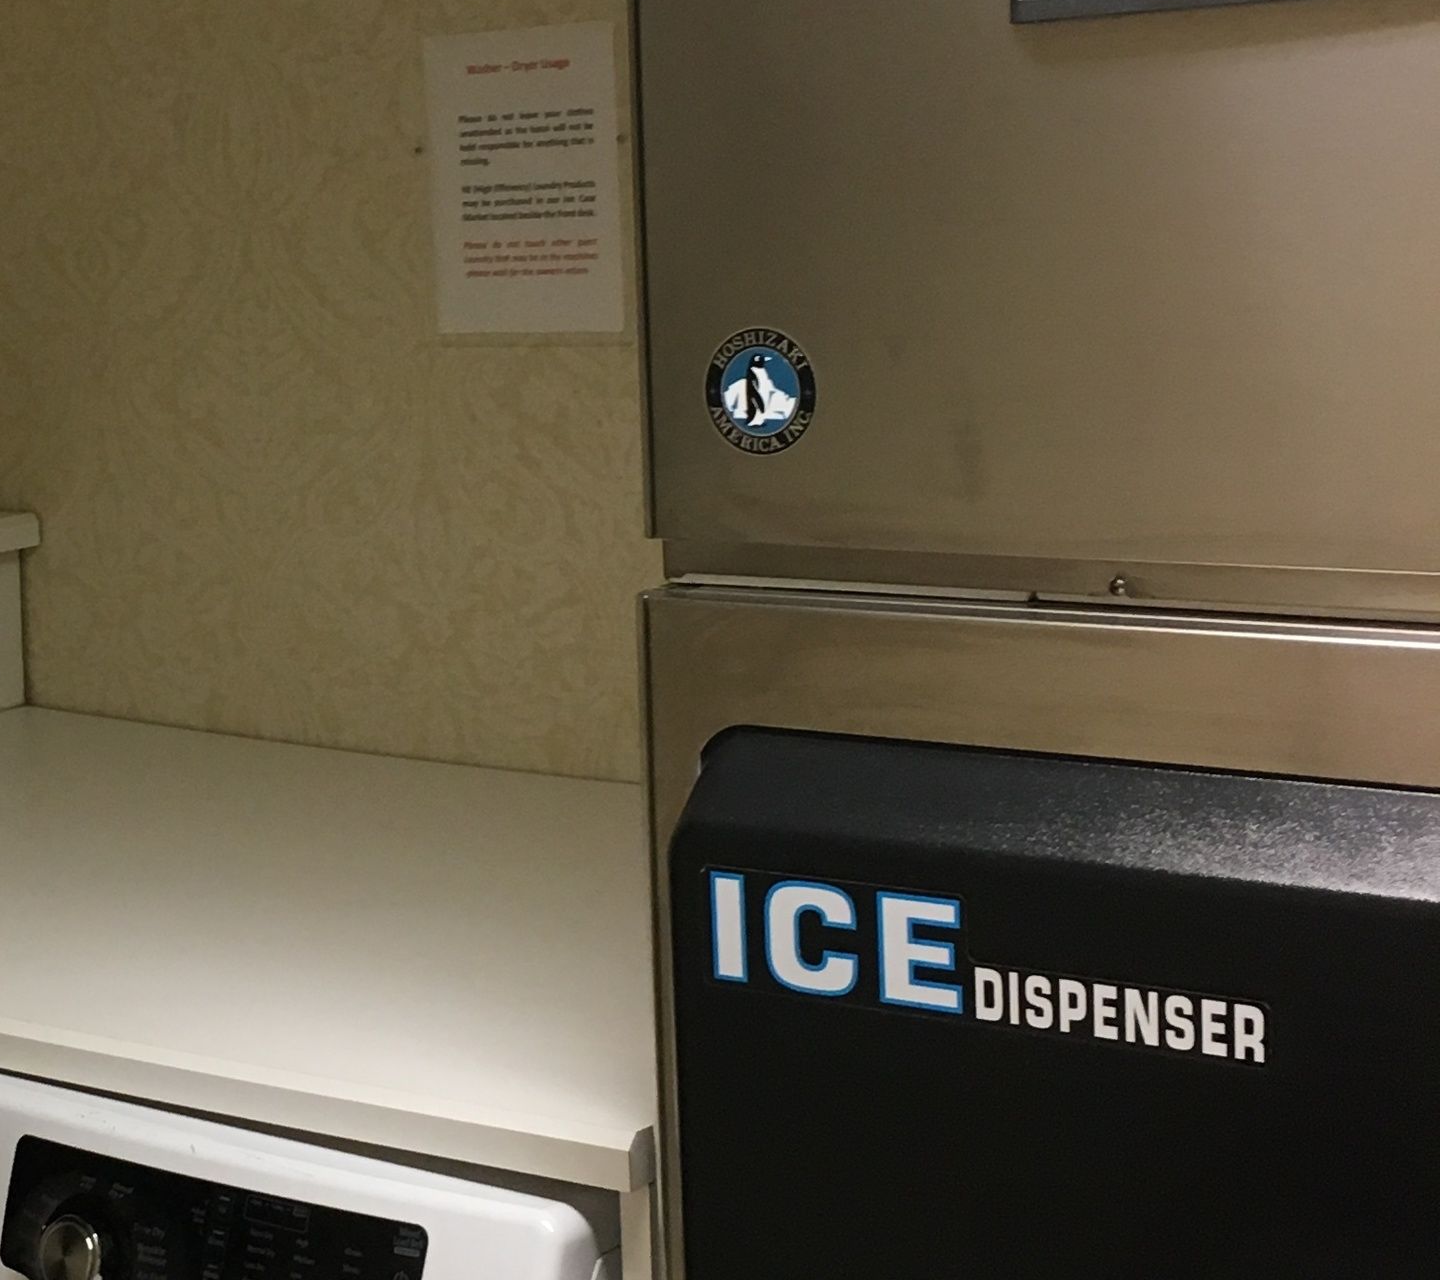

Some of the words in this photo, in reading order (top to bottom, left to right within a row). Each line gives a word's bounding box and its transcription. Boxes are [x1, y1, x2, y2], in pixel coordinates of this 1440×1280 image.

[713, 331, 809, 370] HOSHIZAKI
[710, 870, 963, 1013] ICE
[974, 966, 1266, 1064] DISPENSER
